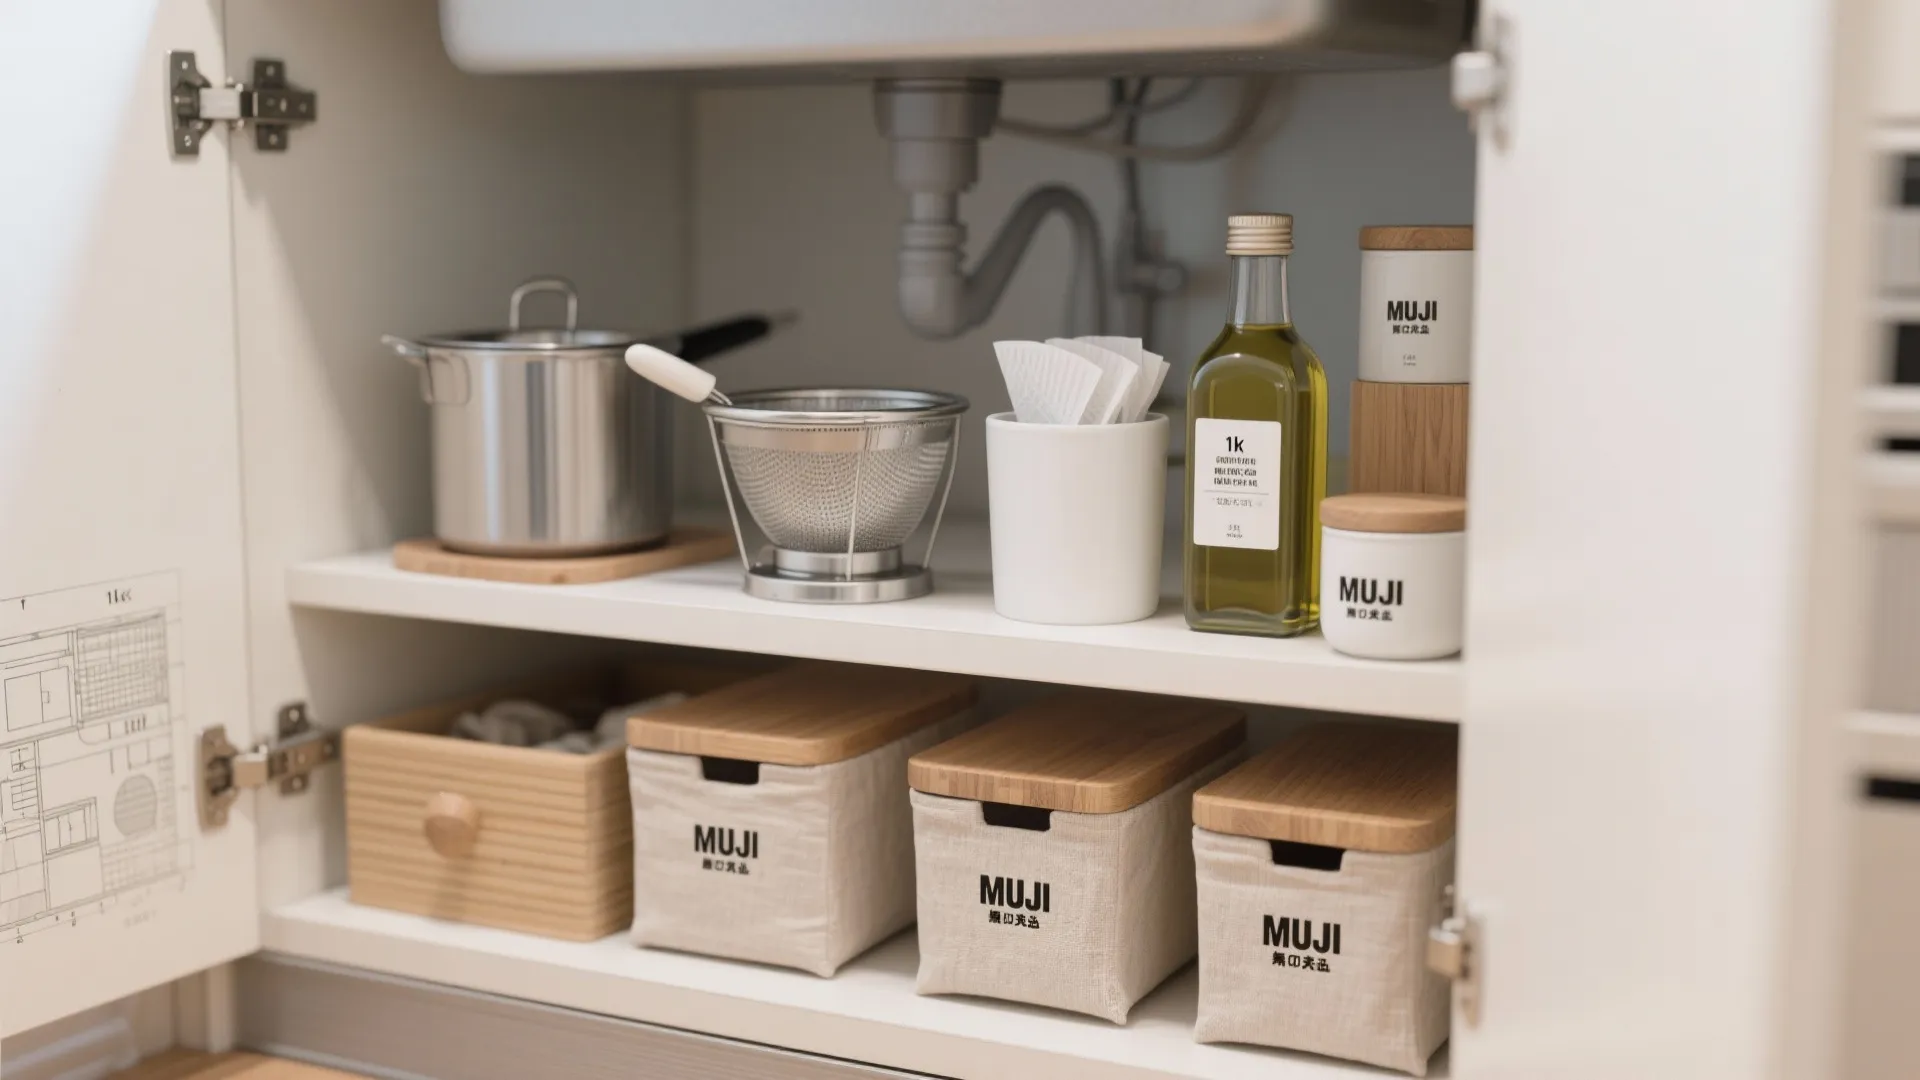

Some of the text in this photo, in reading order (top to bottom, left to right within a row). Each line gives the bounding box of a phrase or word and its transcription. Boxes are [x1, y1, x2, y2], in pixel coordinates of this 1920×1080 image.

[1387, 300, 1437, 321] MUJI
[1226, 436, 1244, 453] 1k
[1340, 576, 1403, 606] MUJI
[694, 824, 758, 859] MUJI
[980, 874, 1050, 913] MUJI
[1263, 914, 1341, 955] MUJI
